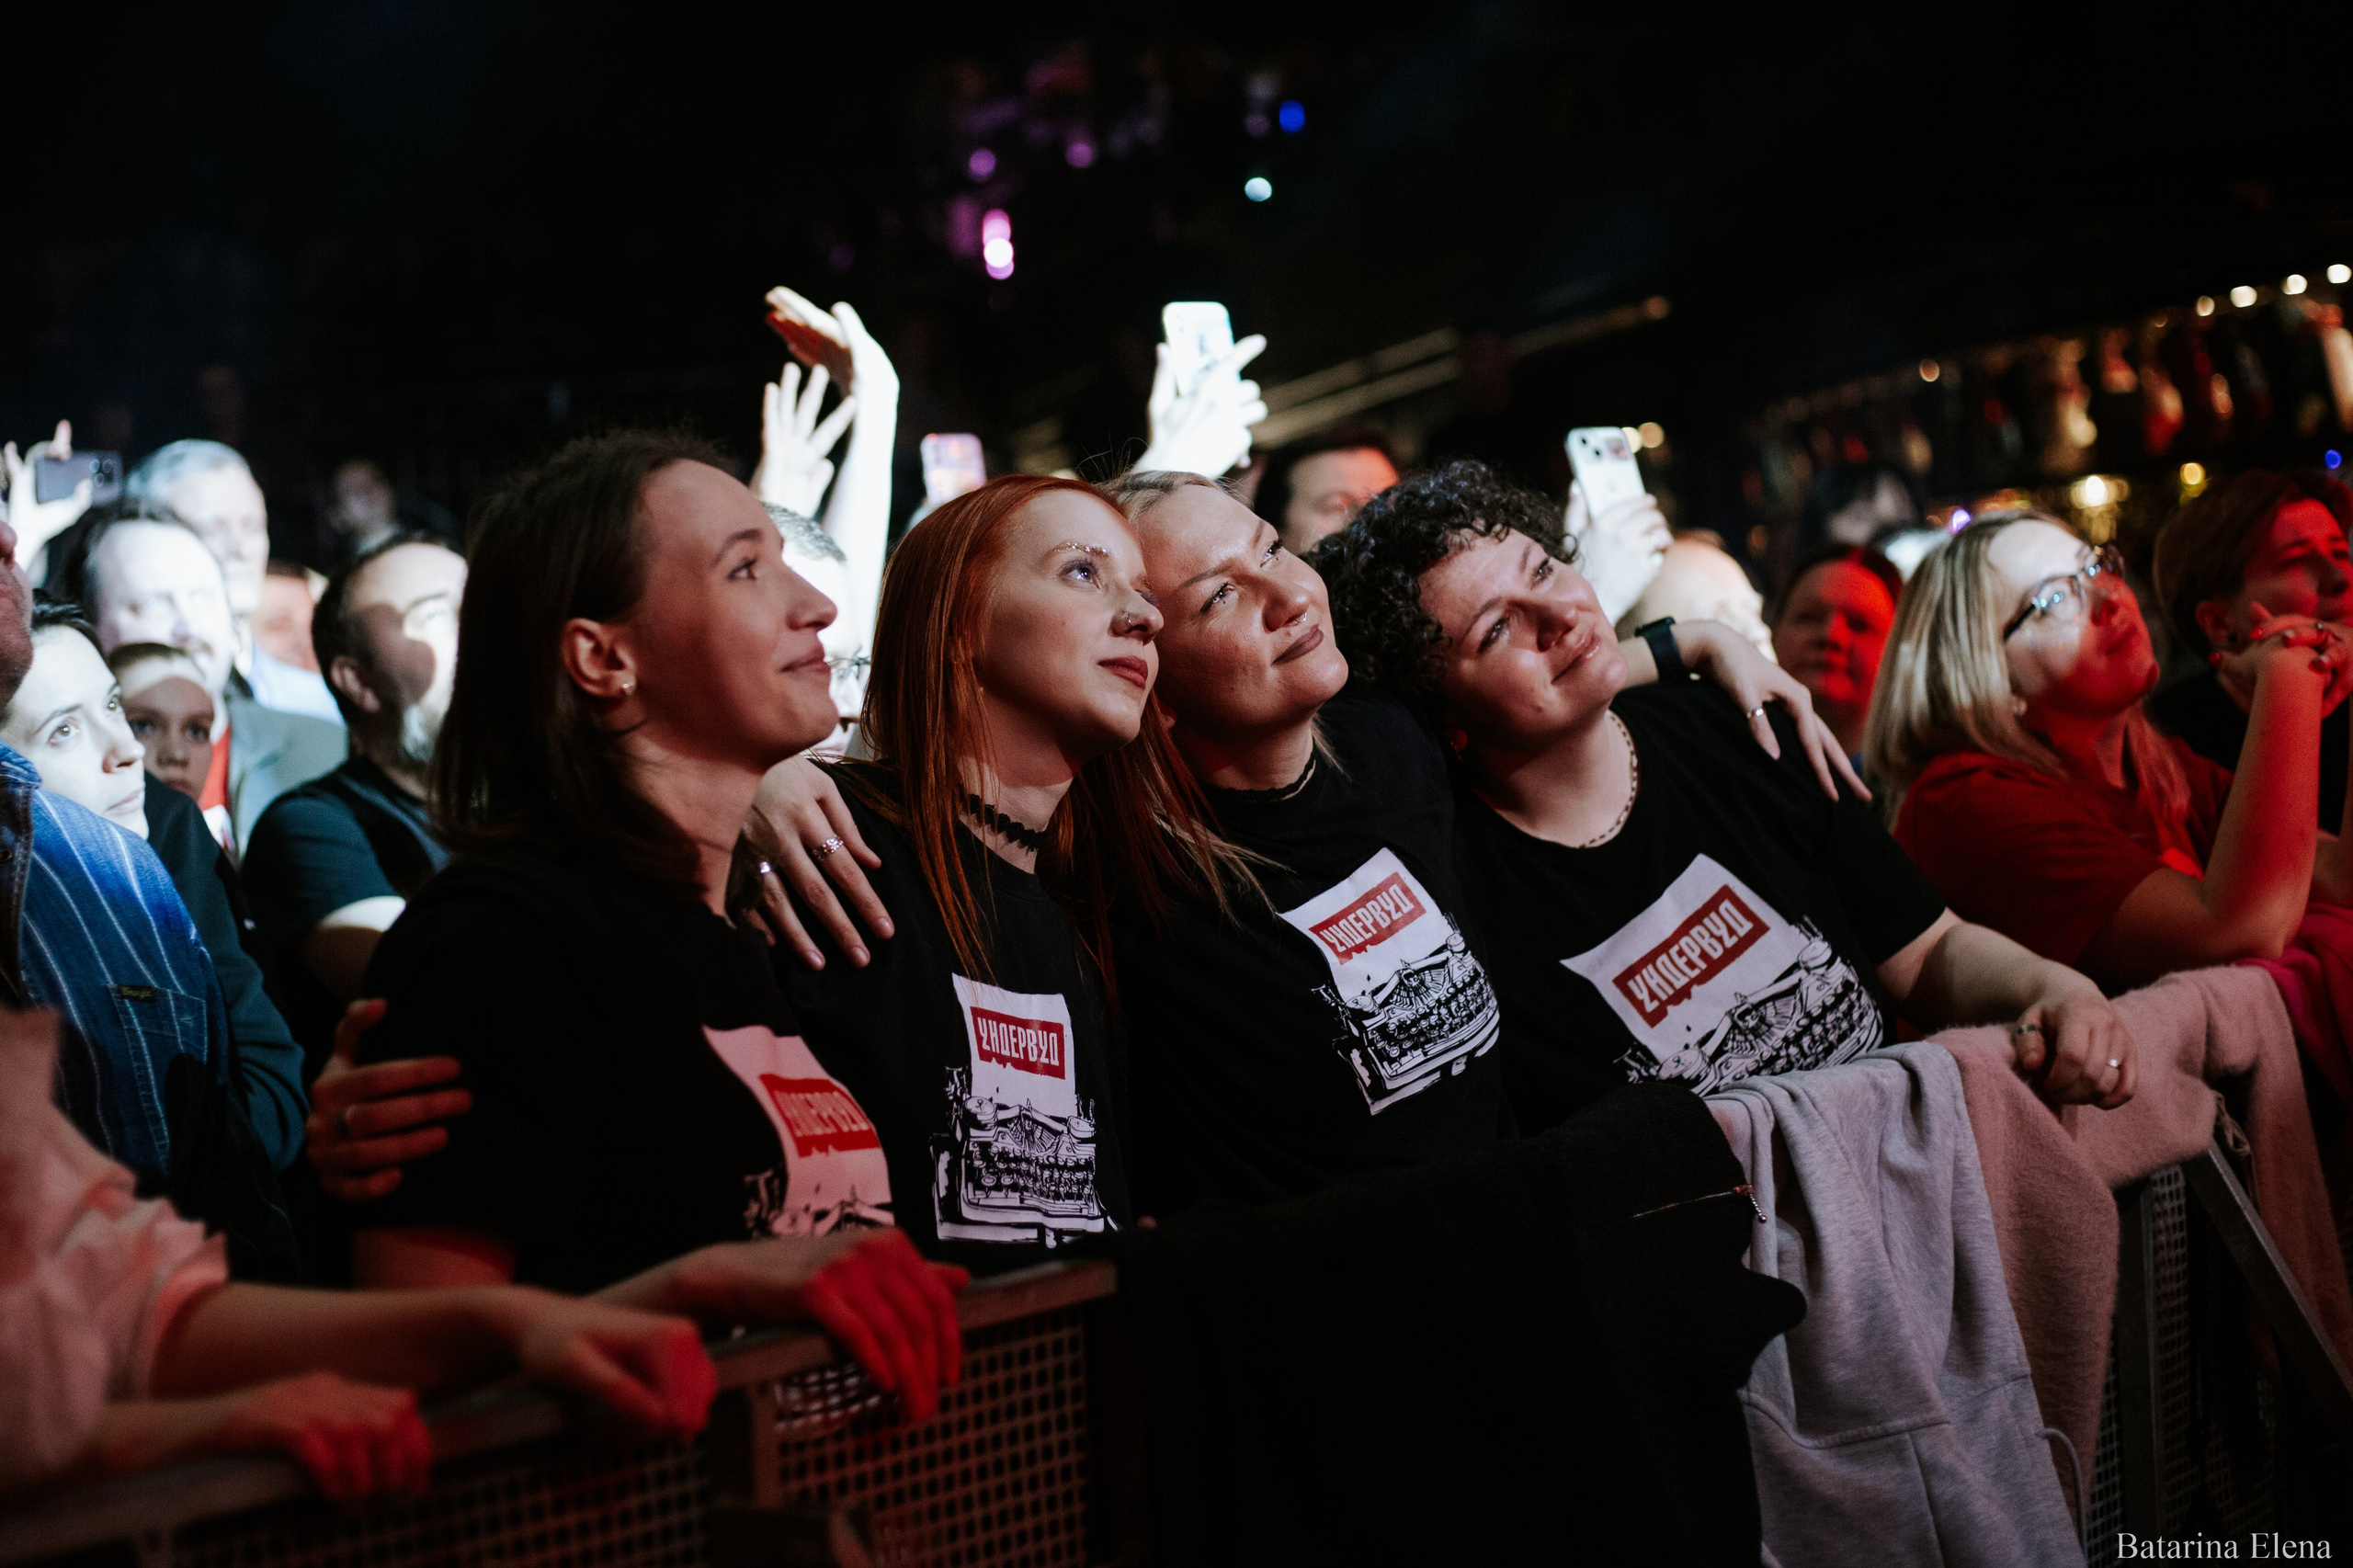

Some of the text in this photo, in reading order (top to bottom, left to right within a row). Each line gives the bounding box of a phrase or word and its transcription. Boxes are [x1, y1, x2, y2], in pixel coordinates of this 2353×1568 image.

[1319, 882, 1415, 953] УНДЕРВУД
[1627, 899, 1754, 1013] УНДЕРВУД
[977, 1017, 1060, 1067] УНДЕРВУД
